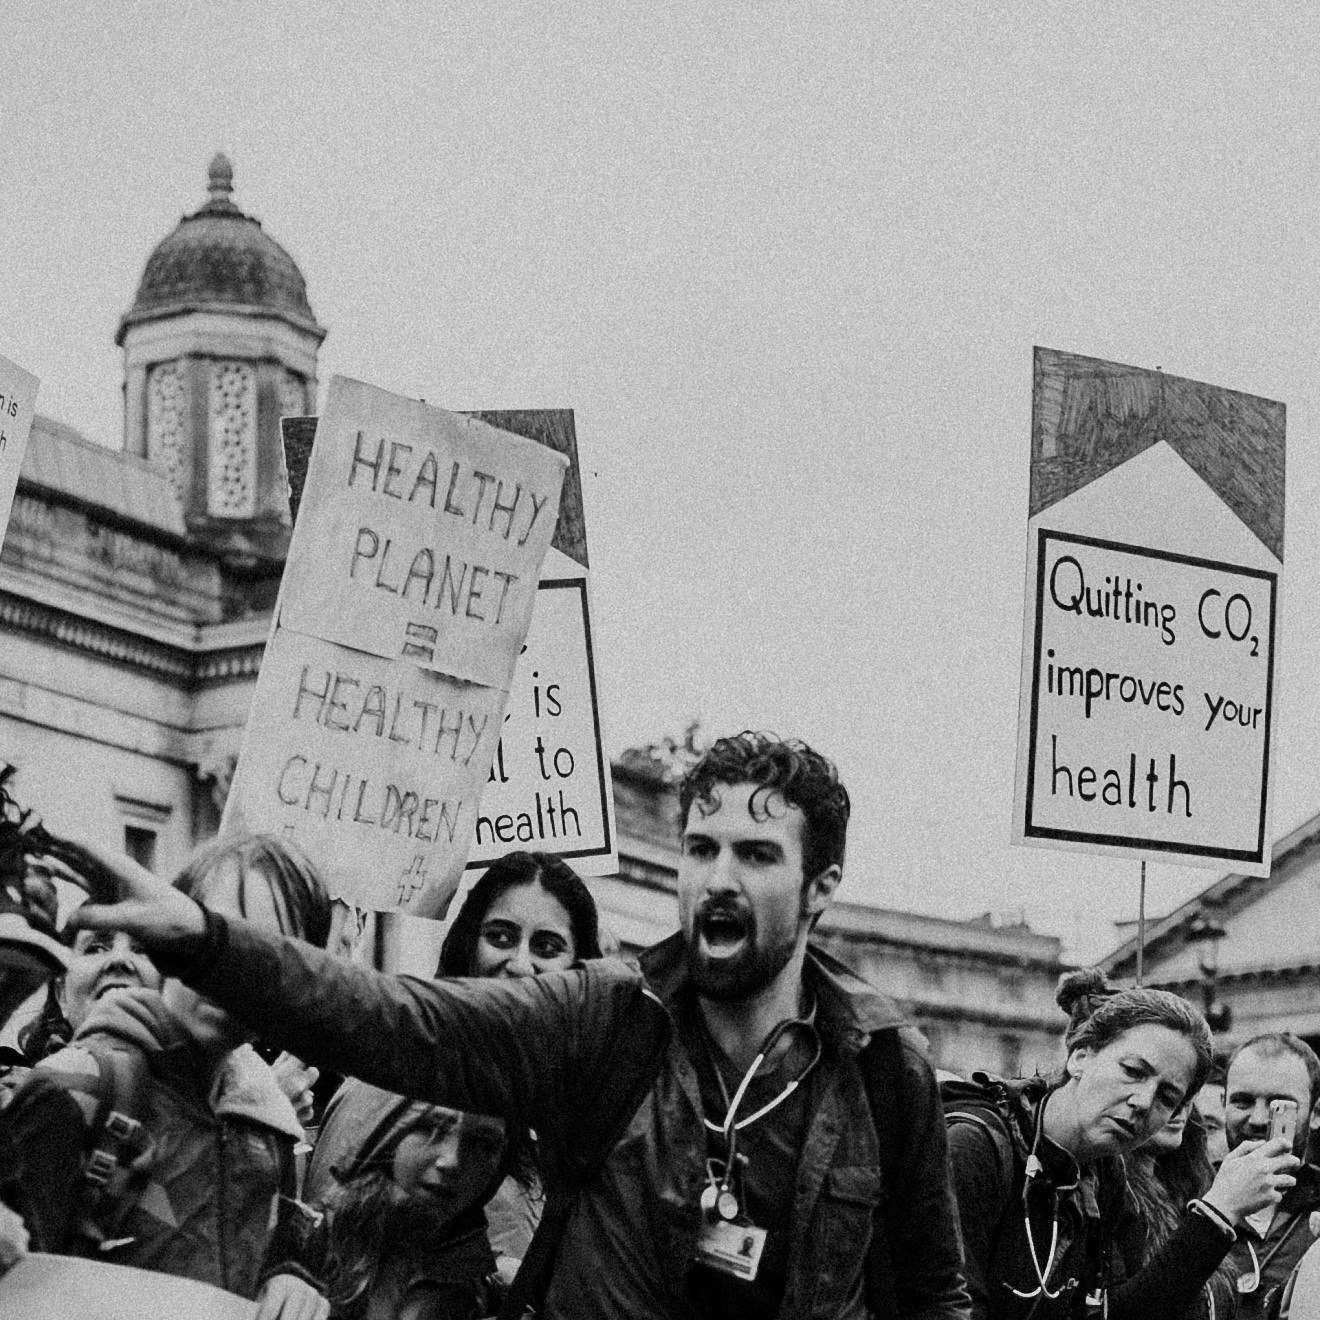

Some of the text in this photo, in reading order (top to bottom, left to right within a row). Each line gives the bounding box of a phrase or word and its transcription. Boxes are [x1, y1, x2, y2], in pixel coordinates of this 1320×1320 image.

[7, 396, 18, 417] is
[348, 431, 548, 546] HEALTHY
[350, 528, 519, 625] PLANET
[1049, 555, 1177, 646] Quitting
[293, 665, 488, 767] HEALTHY
[533, 671, 562, 718] is
[1047, 649, 1262, 731] improves your
[277, 755, 462, 843] CHILDREN
[535, 737, 575, 780] to
[1051, 734, 1193, 818] health
